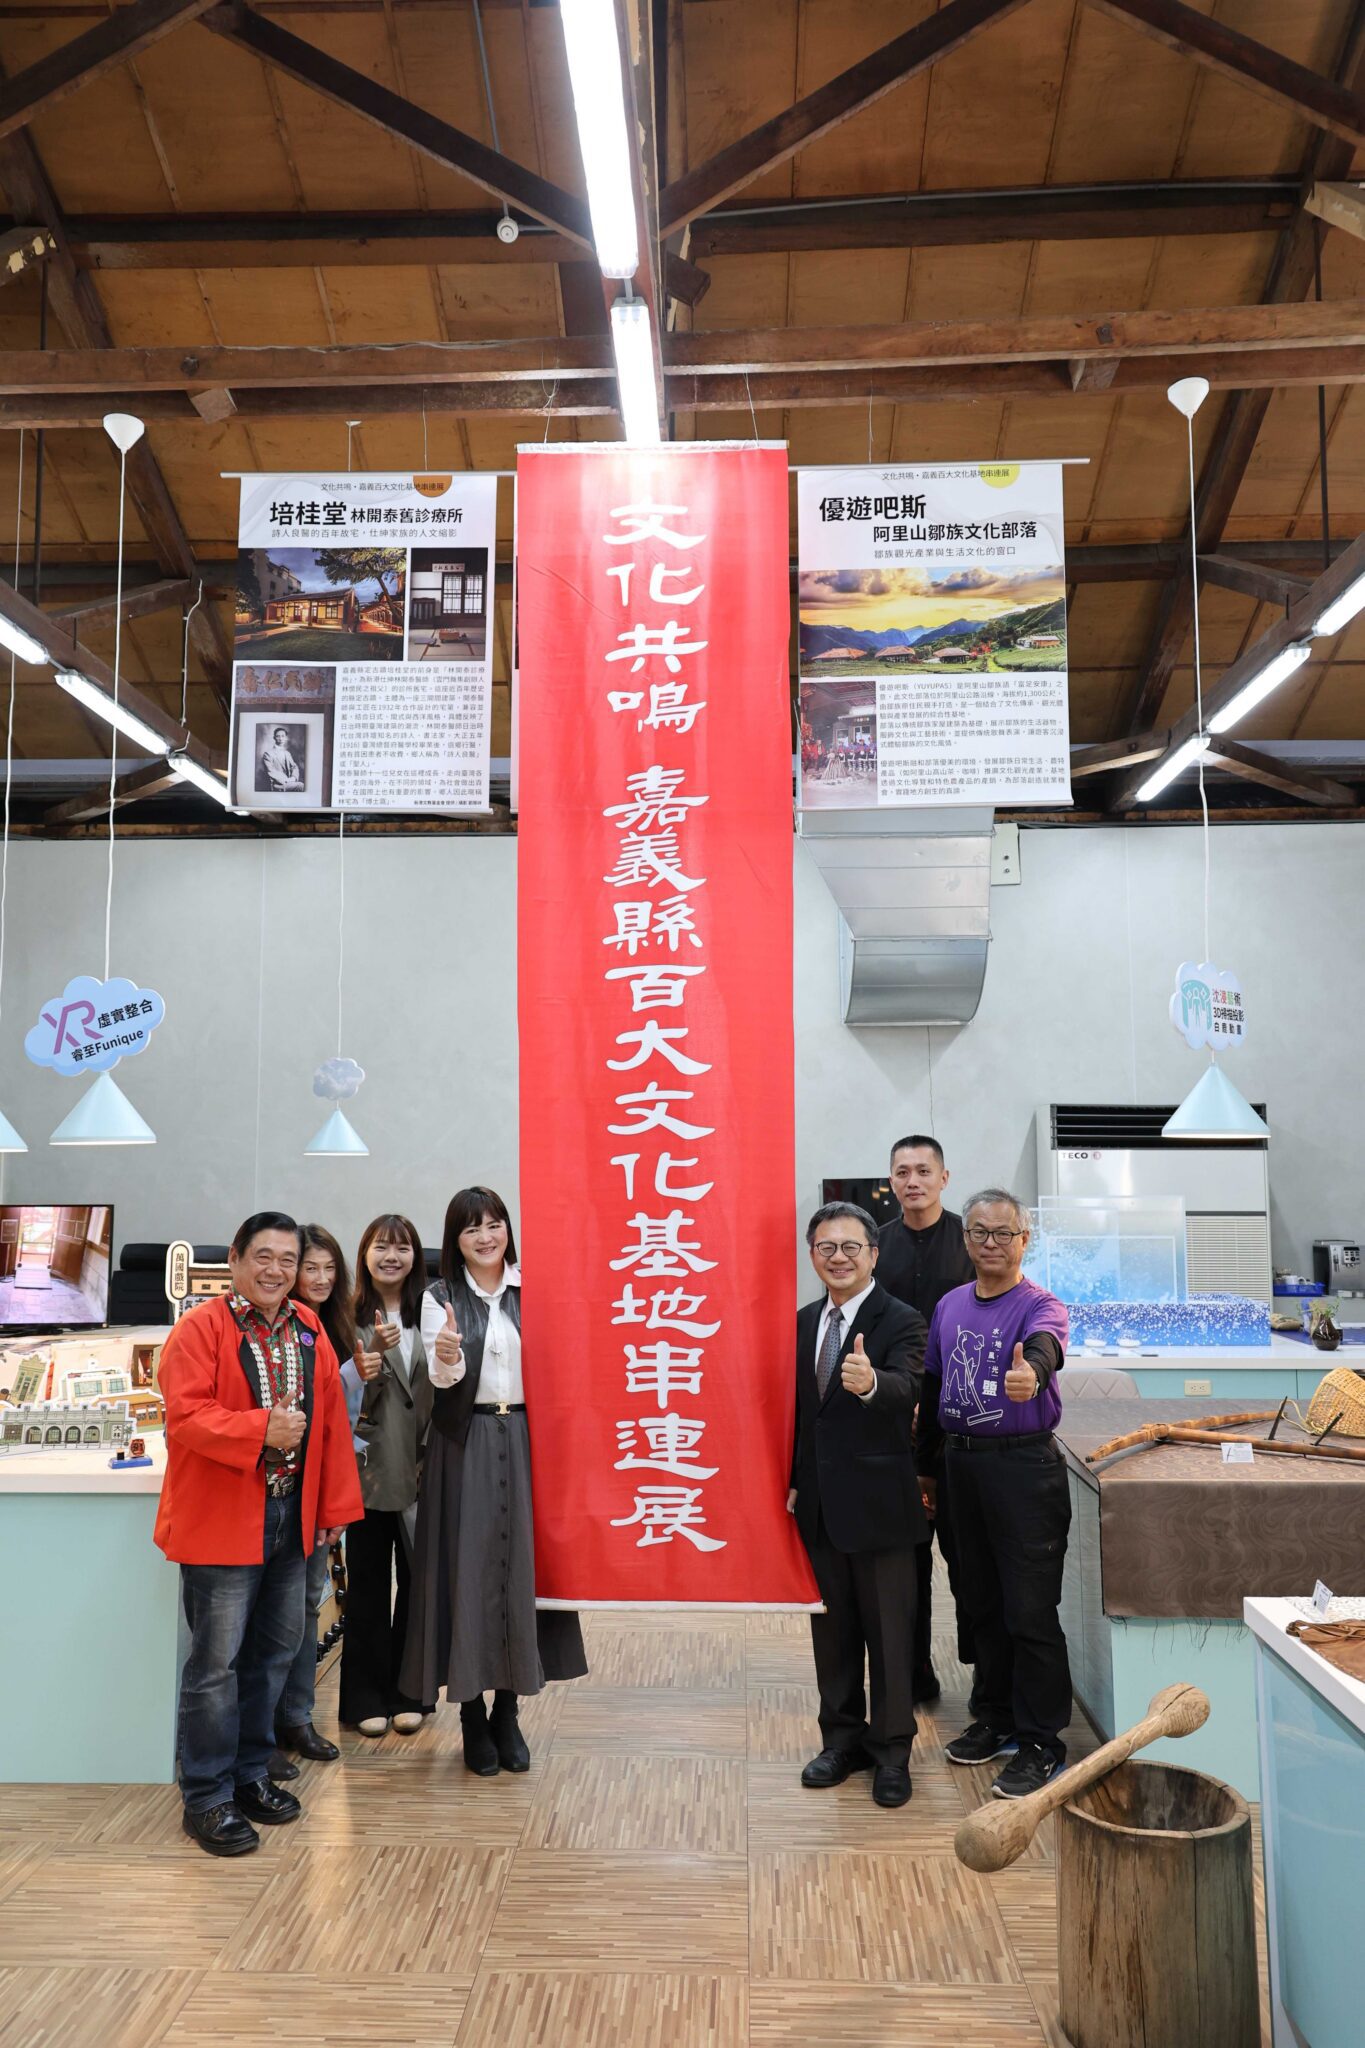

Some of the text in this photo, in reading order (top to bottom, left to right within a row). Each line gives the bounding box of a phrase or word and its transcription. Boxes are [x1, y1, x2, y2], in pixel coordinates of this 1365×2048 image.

[269, 501, 464, 526] 培桂堂 林開泰舊診療所
[819, 494, 927, 522] 優遊吧斯
[873, 521, 1038, 543] 阿里山鄒族文化部落
[874, 546, 1017, 559] 鄒族觀光產業與生活文化的窗口
[41, 1000, 104, 1055] XR
[97, 999, 153, 1029] 虛實整合
[602, 500, 728, 1553] 文化共鳴 嘉義縣百大文化基地串連展
[71, 1029, 144, 1062] 睿至Funique
[1061, 1152, 1089, 1160] TECO
